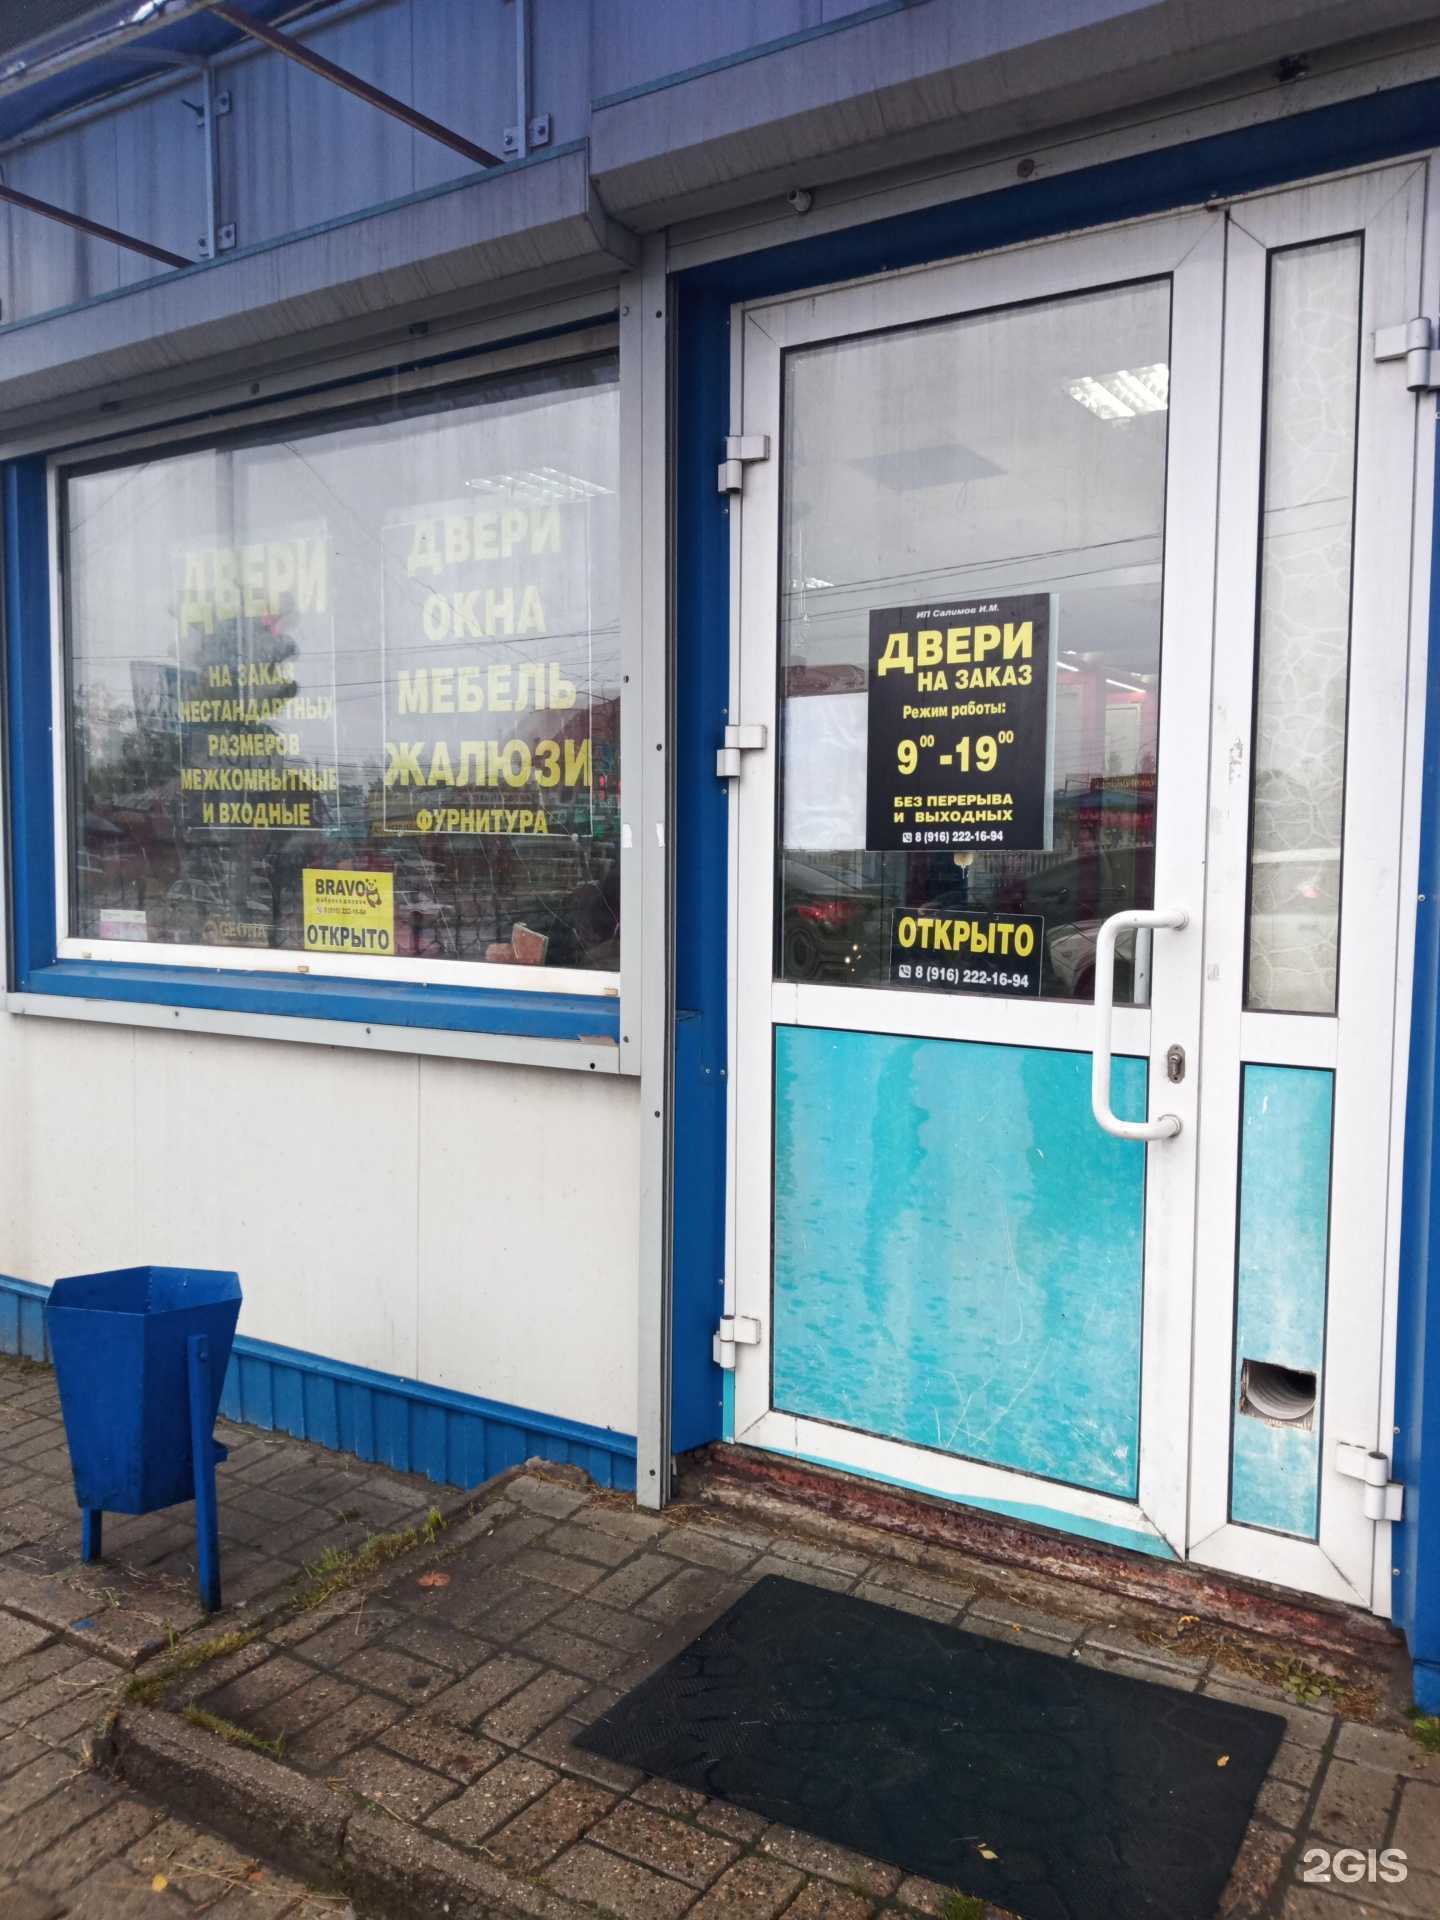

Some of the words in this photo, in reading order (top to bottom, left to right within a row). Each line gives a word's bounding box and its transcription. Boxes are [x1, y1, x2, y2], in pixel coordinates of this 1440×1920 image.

[407, 502, 561, 577] ДВЕРИ
[179, 541, 329, 639] ДВЕРИ
[423, 585, 547, 641] ОКНА
[916, 610, 931, 619] ИП
[877, 621, 1033, 677] ДВЕРИ
[208, 663, 232, 688] НА
[238, 662, 294, 686] ЗАКАЗ
[917, 671, 949, 692] НА
[955, 664, 1033, 690] ЗАКАЗ
[397, 662, 577, 715] МЕБЕЛЬ
[903, 705, 948, 719] Режим
[951, 701, 1007, 719] работы:
[208, 734, 300, 757] РАЗМЕРОВ
[384, 738, 592, 788] ЖАЛЮЗИ
[894, 796, 922, 808] БЕЗ
[927, 793, 1014, 807] ПЕРЕРЫВА
[203, 803, 214, 823] И
[219, 802, 311, 828] ВХОДНЫЕ
[416, 808, 549, 834] ФУРНИТУРА
[894, 812, 904, 823] И
[915, 809, 1013, 823] ВЫХОДНЫХ
[915, 832, 922, 842] 8
[924, 831, 950, 844] (916)
[952, 831, 1004, 842] 222-16-94
[315, 878, 366, 897] BRAVO
[307, 924, 389, 950] ОТКРЫТО
[898, 916, 1034, 957] ОТКРЫТО
[915, 966, 923, 978] 8
[926, 966, 959, 984] (916)
[963, 969, 1029, 988] 222-16-94
